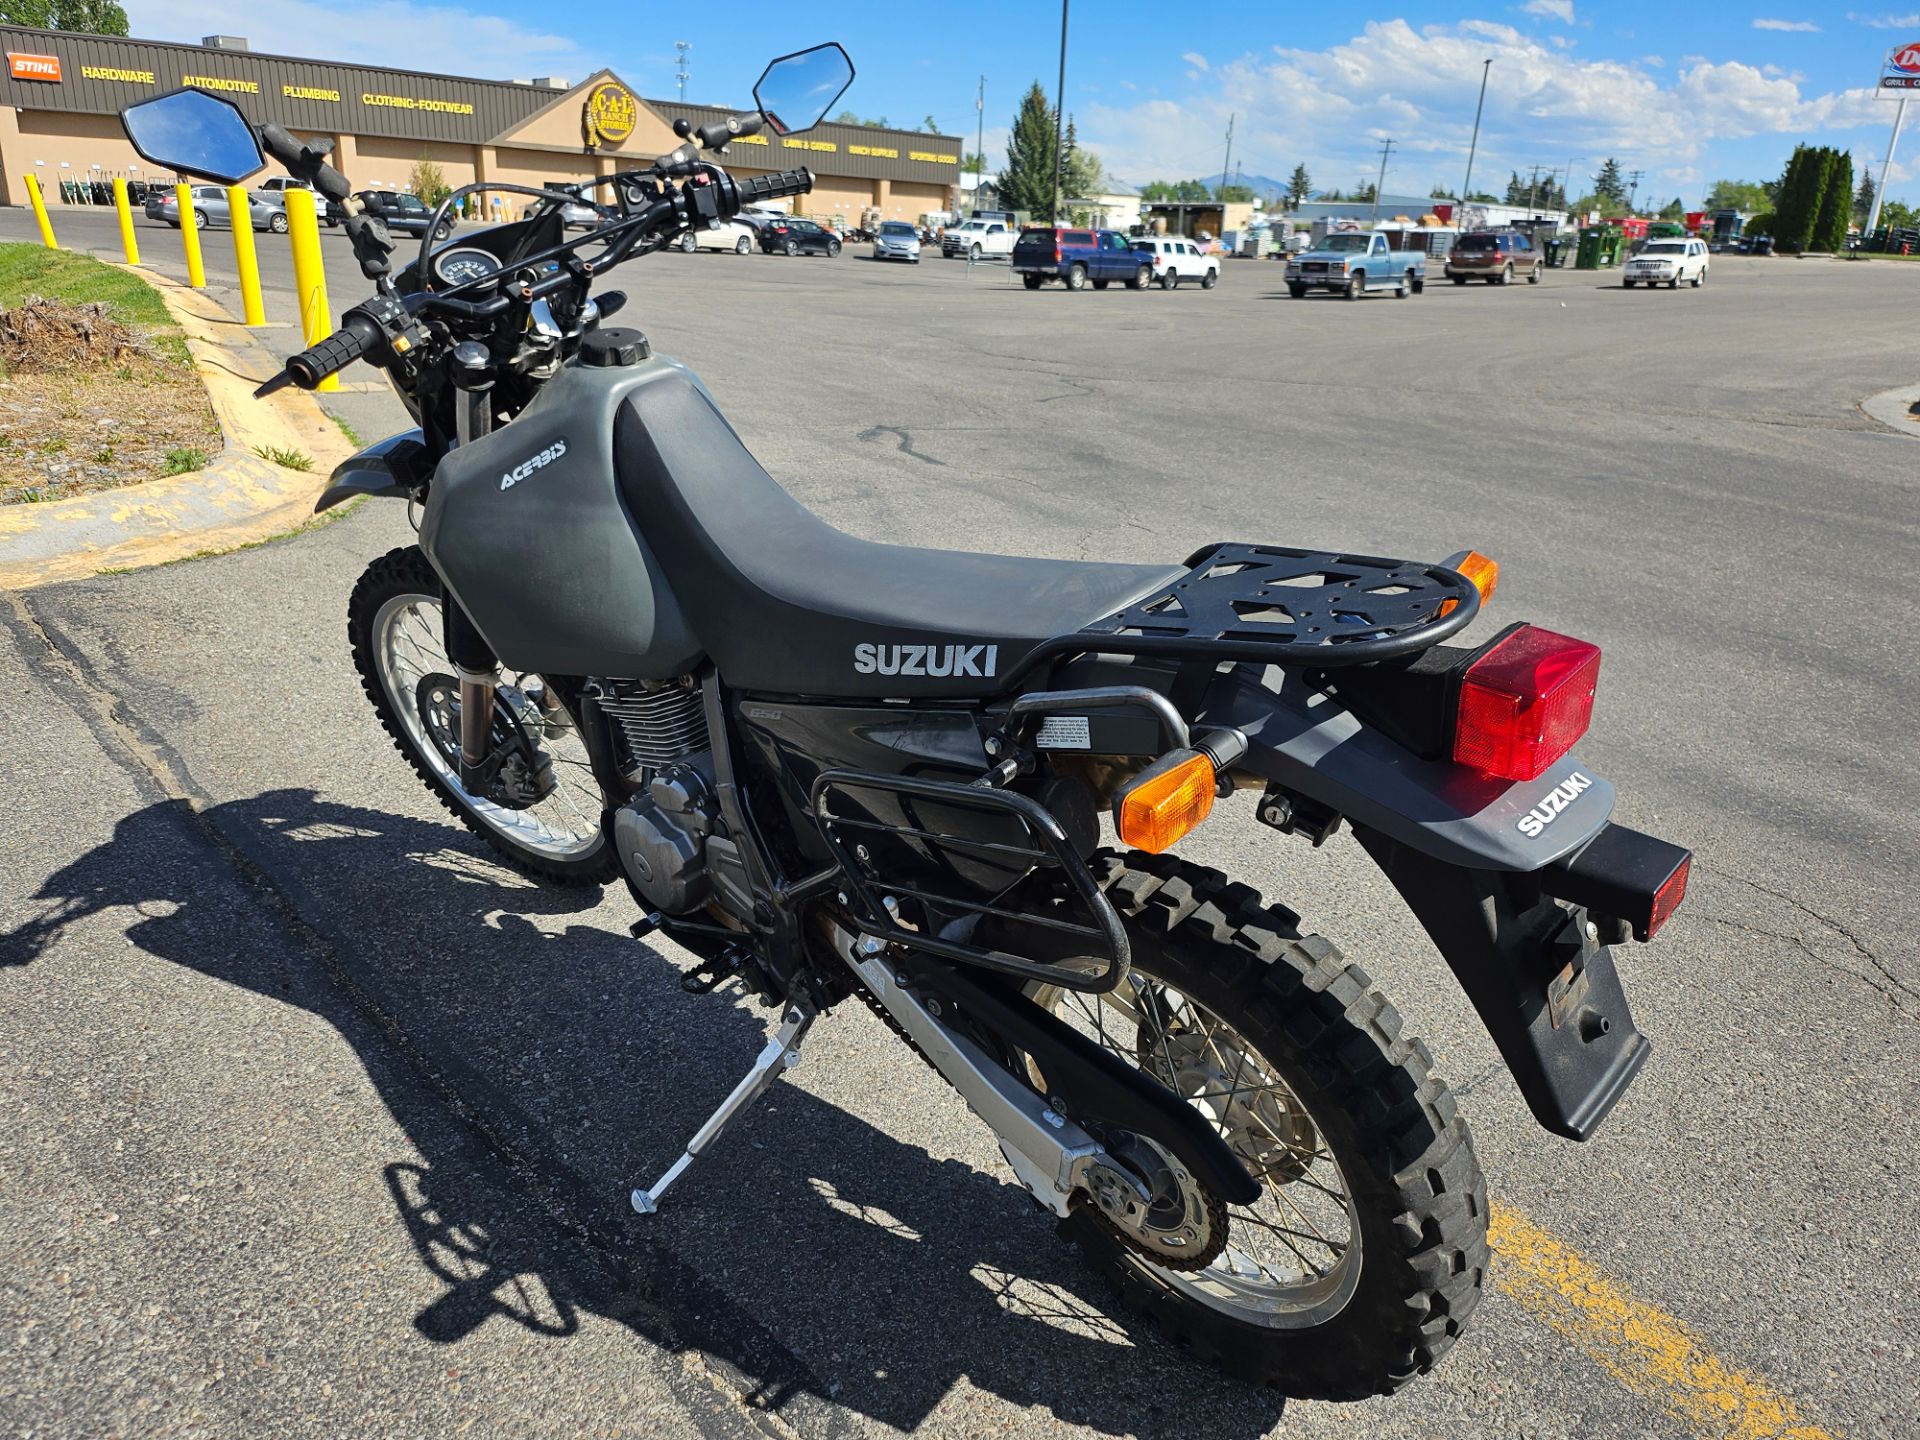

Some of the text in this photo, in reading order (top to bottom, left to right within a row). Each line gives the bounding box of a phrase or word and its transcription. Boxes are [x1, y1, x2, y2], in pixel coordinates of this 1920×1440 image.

[15, 60, 57, 75] STIHL
[81, 66, 155, 84] HARDWARE
[182, 75, 259, 94] AUTOMOTIVE
[1885, 79, 1906, 87] GRILL
[283, 85, 340, 102] PLUMBING
[362, 93, 473, 115] CLOTHING-FOOTWEAR
[601, 111, 629, 123] RANCH
[600, 120, 630, 132] STORES
[853, 643, 998, 678] SUZUKI
[751, 708, 782, 720] 650
[1517, 771, 1593, 838] SUZUKI
